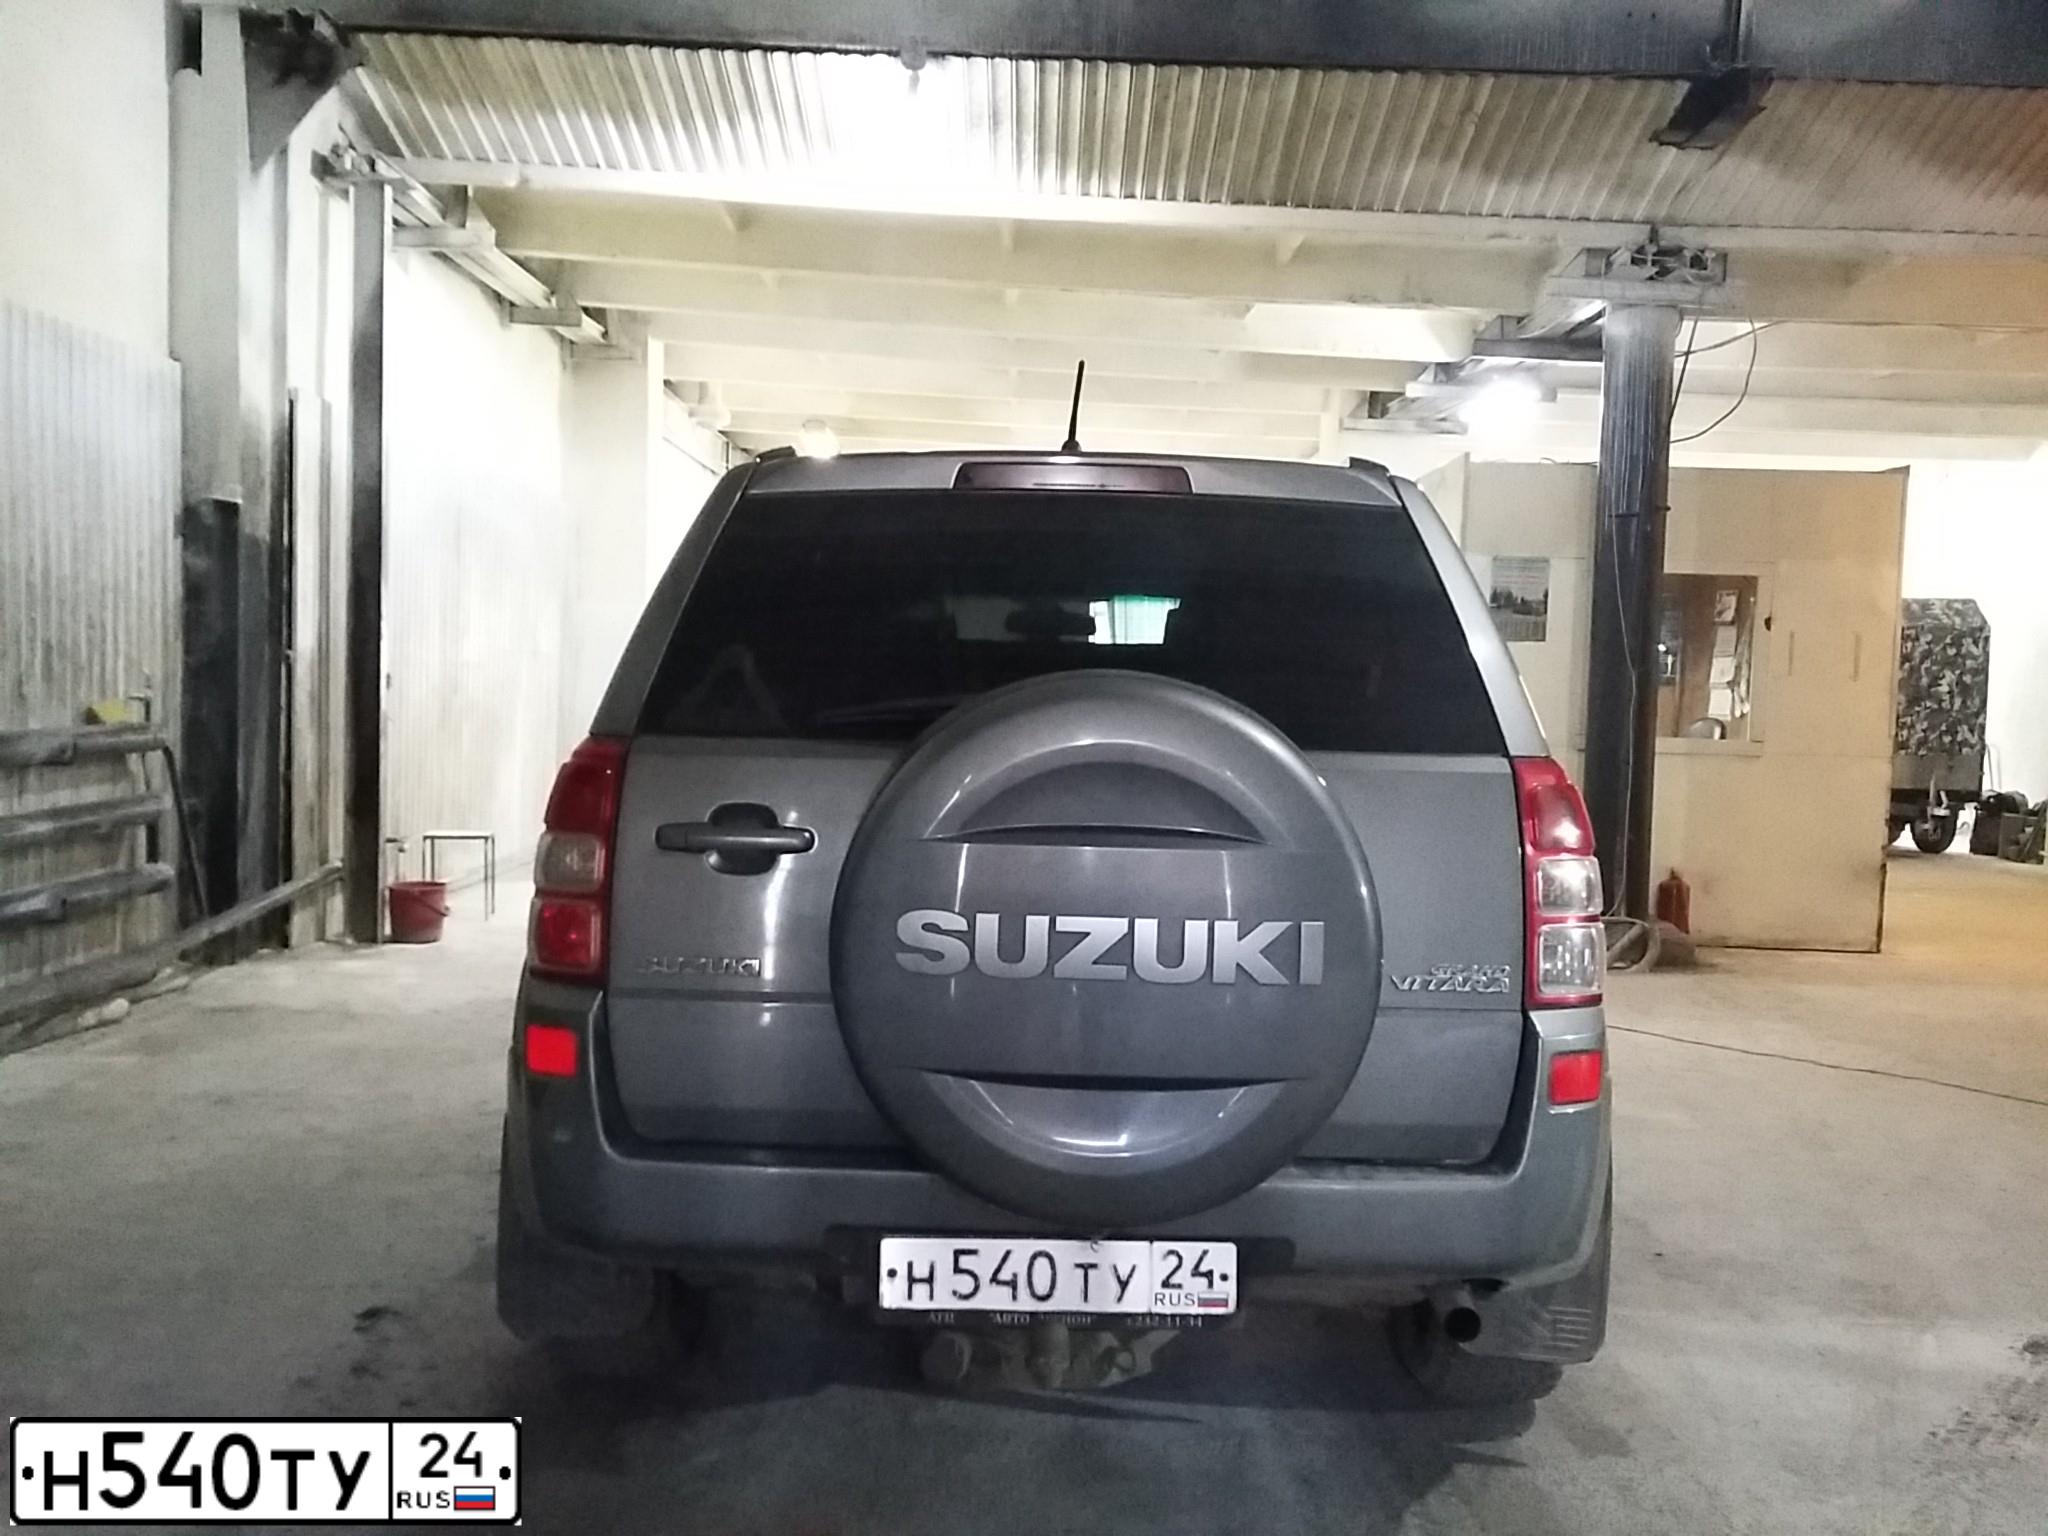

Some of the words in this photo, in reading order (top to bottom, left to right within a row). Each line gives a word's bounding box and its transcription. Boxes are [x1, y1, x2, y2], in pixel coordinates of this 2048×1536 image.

[895, 908, 1325, 985] SUZUKI
[1160, 1249, 1214, 1290] 24
[1154, 1292, 1195, 1307] RUS
